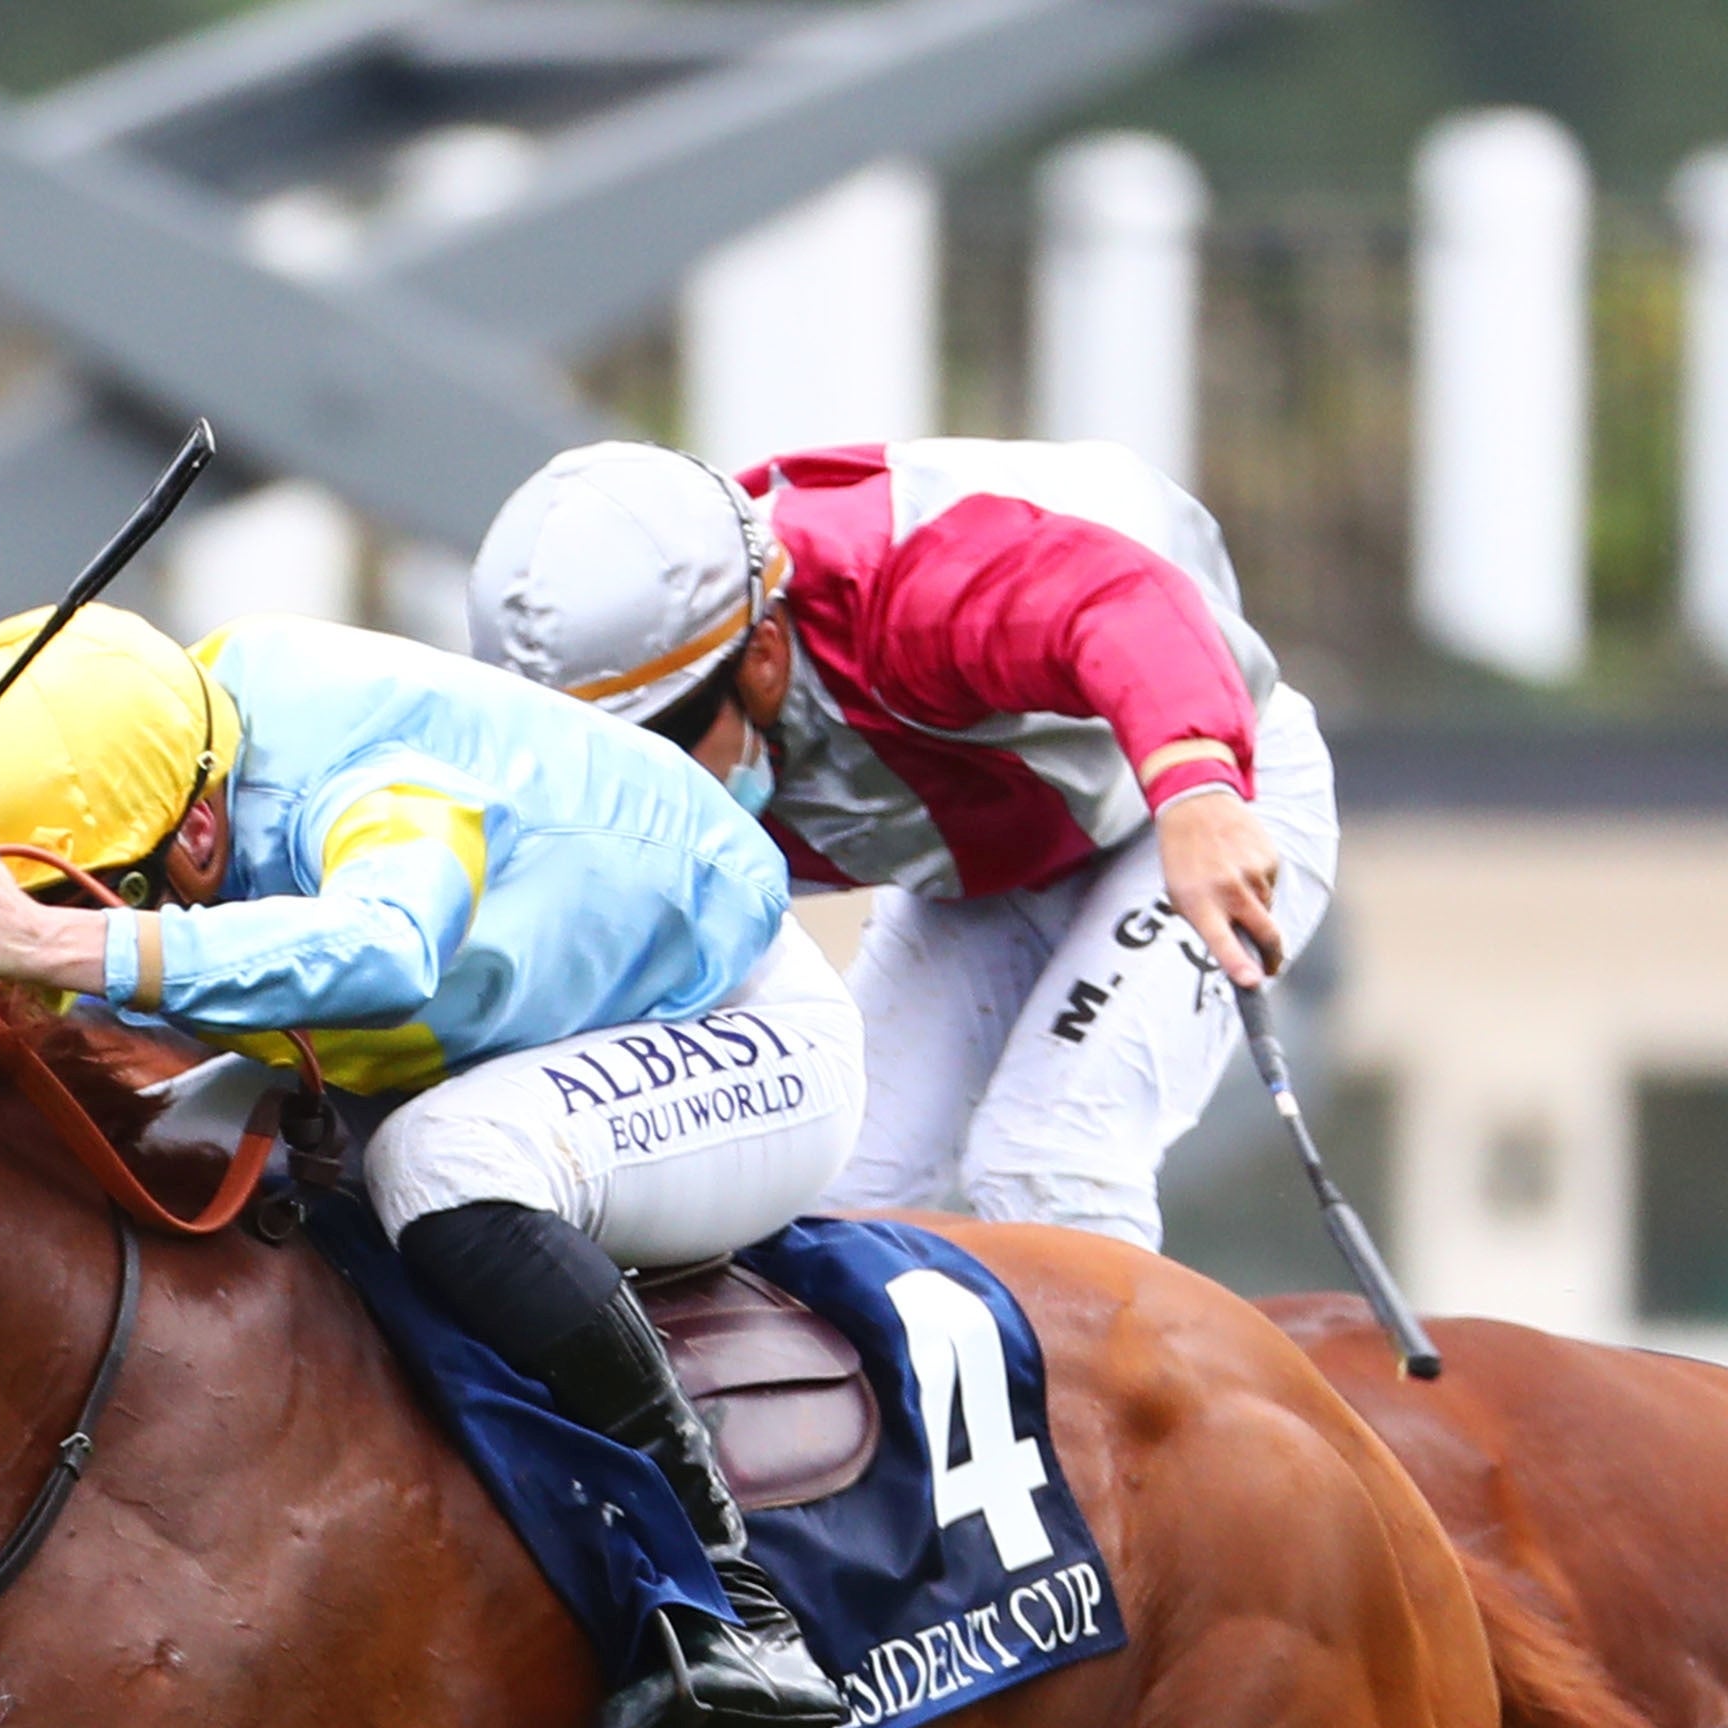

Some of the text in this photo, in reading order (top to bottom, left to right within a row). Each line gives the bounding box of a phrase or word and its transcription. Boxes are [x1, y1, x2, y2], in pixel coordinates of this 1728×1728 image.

[1051, 972, 1123, 1044] M.
[541, 1011, 816, 1115] ALBAST
[608, 1073, 805, 1154] EQUIWORLD
[885, 1268, 1055, 1574] 4
[1009, 1562, 1102, 1653] CUP
